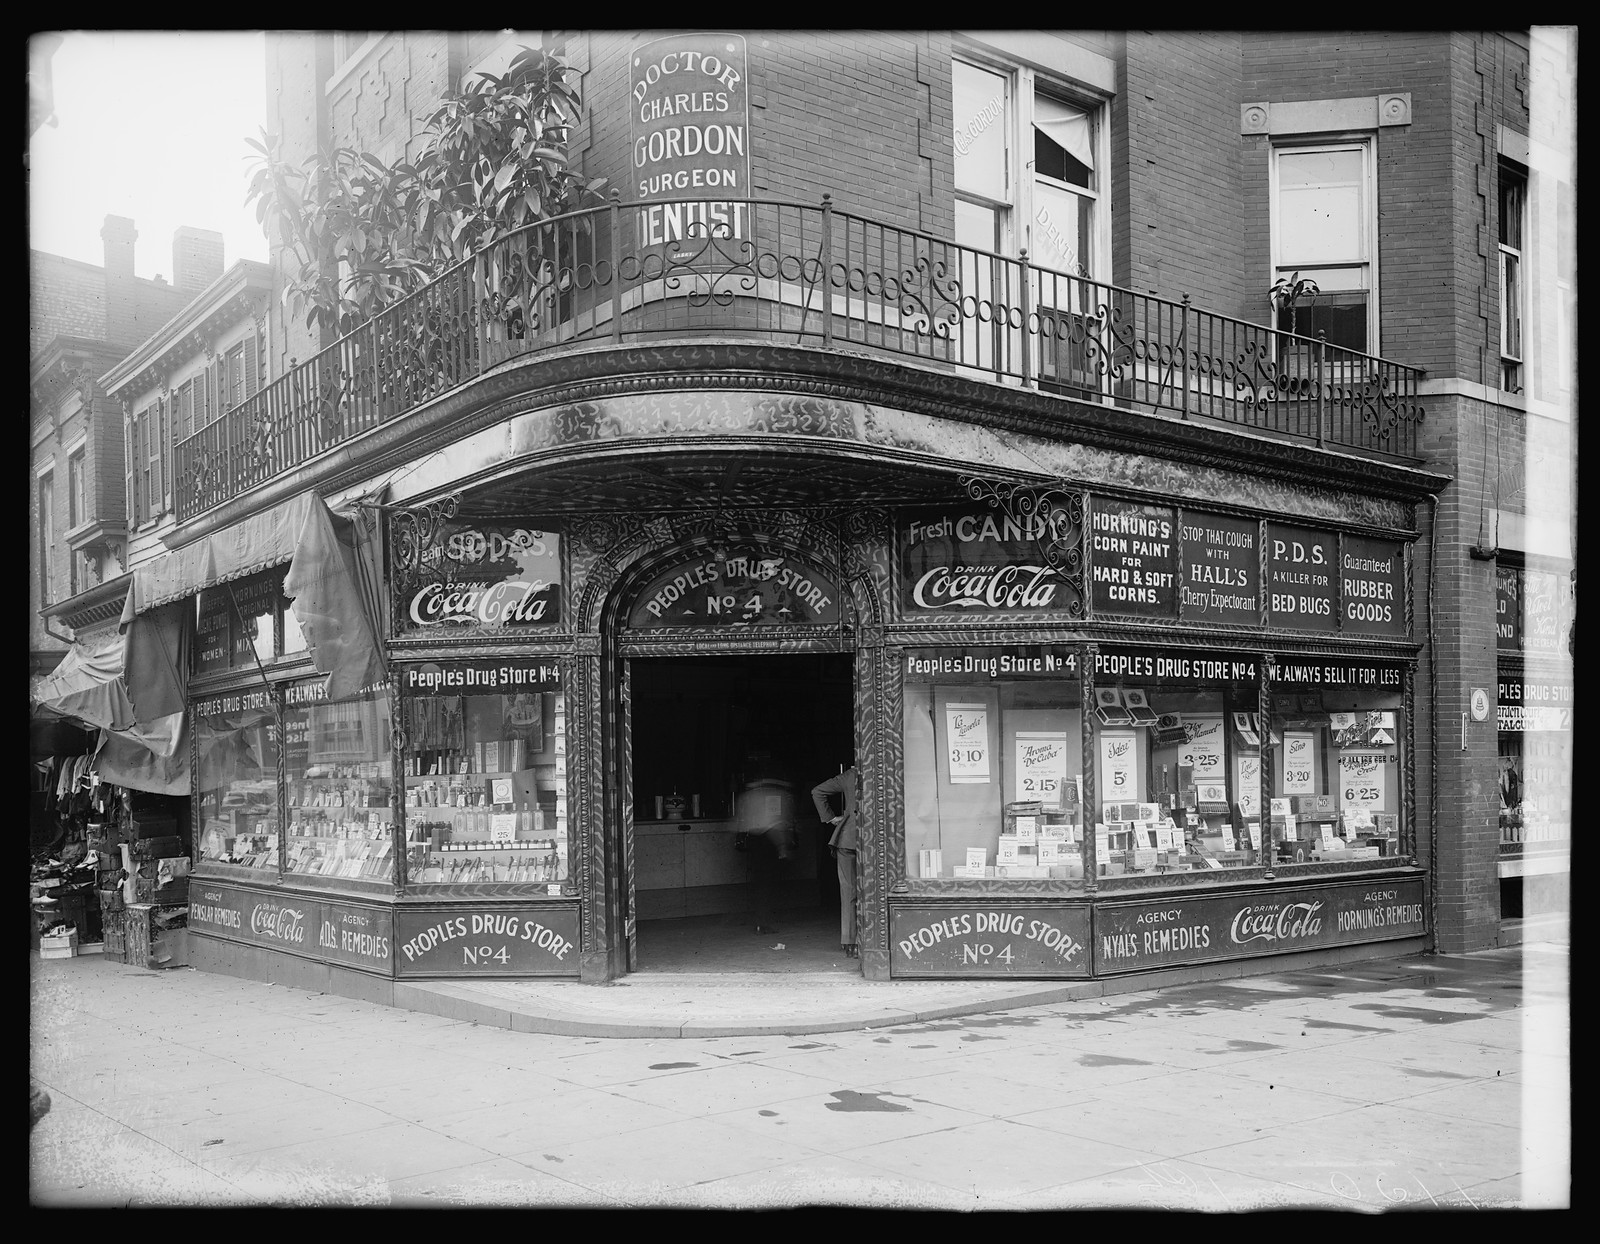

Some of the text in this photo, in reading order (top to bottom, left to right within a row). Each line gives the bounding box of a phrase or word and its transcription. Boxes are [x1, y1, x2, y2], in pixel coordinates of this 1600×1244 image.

[633, 51, 741, 104] DOCTOR
[641, 92, 729, 123] CHARLES
[634, 125, 744, 168] GORDON
[639, 169, 736, 198] SURGEON
[910, 516, 953, 545] Fresh
[1093, 512, 1171, 539] HORNUNG'S
[1094, 535, 1170, 558] CORN PAINT
[1182, 526, 1253, 549] STOP THAT COUGH
[1122, 557, 1142, 568] FOR
[1205, 548, 1230, 561] WITH
[1344, 553, 1391, 574] Guaranteed
[954, 565, 997, 574] DRINK
[1093, 566, 1174, 589] HARD & SOFT
[1191, 564, 1248, 587] HALL'S
[1273, 571, 1329, 587] A KILLER FOR
[445, 581, 489, 590] DRINK
[777, 568, 832, 615] STORE
[1109, 586, 1161, 604] CORNS.
[1344, 579, 1394, 601] RUBBER
[744, 595, 763, 614] 4
[1182, 586, 1256, 613] Cherry Expectorant
[1272, 594, 1331, 616] BED BUGS
[1348, 602, 1392, 623] GOODS
[202, 647, 224, 662] WOMEN
[908, 656, 962, 676] People's
[964, 656, 997, 677] Drug
[1001, 655, 1042, 672] Store
[1066, 654, 1076, 671] 4
[1095, 655, 1152, 675] PEOPLE'S
[1157, 658, 1190, 678] DRUG
[1193, 660, 1229, 679] STORE
[1269, 664, 1400, 685] WE ALWAYS SELL IT FOR LESS
[410, 668, 464, 691] People's
[467, 668, 497, 687] Drug
[500, 667, 536, 684] Store
[223, 697, 240, 713] DRUG
[242, 692, 264, 710] STORE
[285, 688, 295, 704] WE
[296, 683, 323, 703] ALWAYS
[1524, 684, 1549, 700] DRUG
[1497, 720, 1535, 730] TALCUM
[952, 749, 961, 762] 3
[1023, 778, 1035, 791] 2
[1286, 770, 1294, 782] 3
[1345, 788, 1355, 800] 6
[1364, 889, 1399, 902] AGENCY
[214, 907, 241, 929] REMEDIES
[262, 903, 279, 912] DRINK
[1136, 909, 1182, 925] AGENCY
[1254, 904, 1280, 912] DRINK
[1338, 903, 1423, 932] HORNUNG'S REMEDIES
[343, 914, 369, 926] AGENCY
[342, 929, 388, 959] REMEDIES
[402, 914, 573, 962] PEOPLES DRUG STORE
[899, 912, 1083, 962] PEOPLES DRUG STORE
[1103, 924, 1210, 960] NYAL'S REMEDIES
[996, 943, 1015, 965] 4
